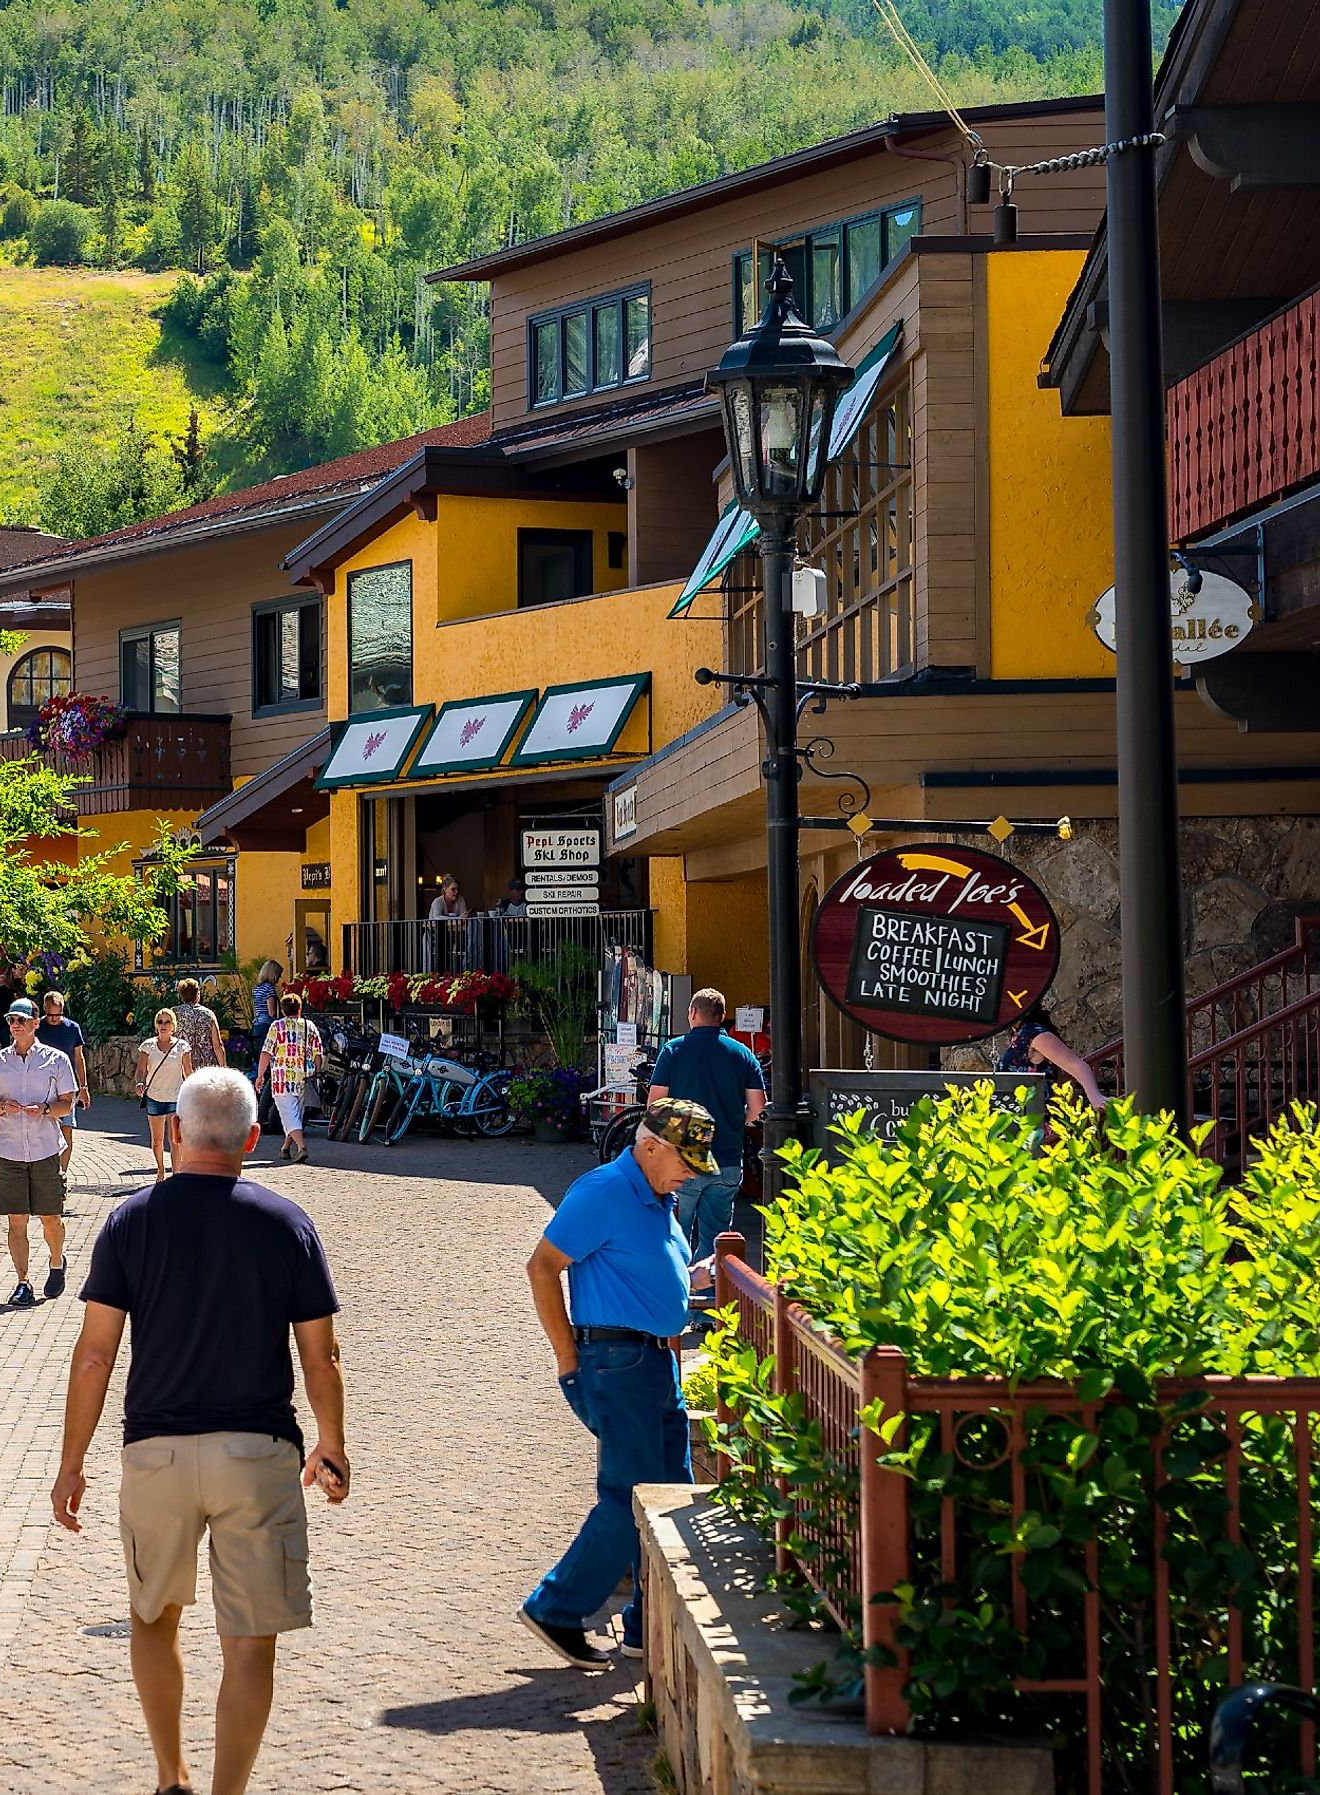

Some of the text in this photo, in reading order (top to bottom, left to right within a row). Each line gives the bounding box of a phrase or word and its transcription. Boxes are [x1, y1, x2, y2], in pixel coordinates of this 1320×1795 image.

[1171, 618, 1239, 640] allée
[525, 835, 596, 848] Pepi Sports
[533, 849, 589, 862] Ski Shop
[542, 890, 582, 899] SKI REPAIR
[529, 906, 597, 915] CUSTOM ORTHOTICS
[872, 913, 993, 956] BREAKFAST
[879, 963, 987, 996] SMOOTHIES
[860, 980, 984, 1013] LATE NIGHT
